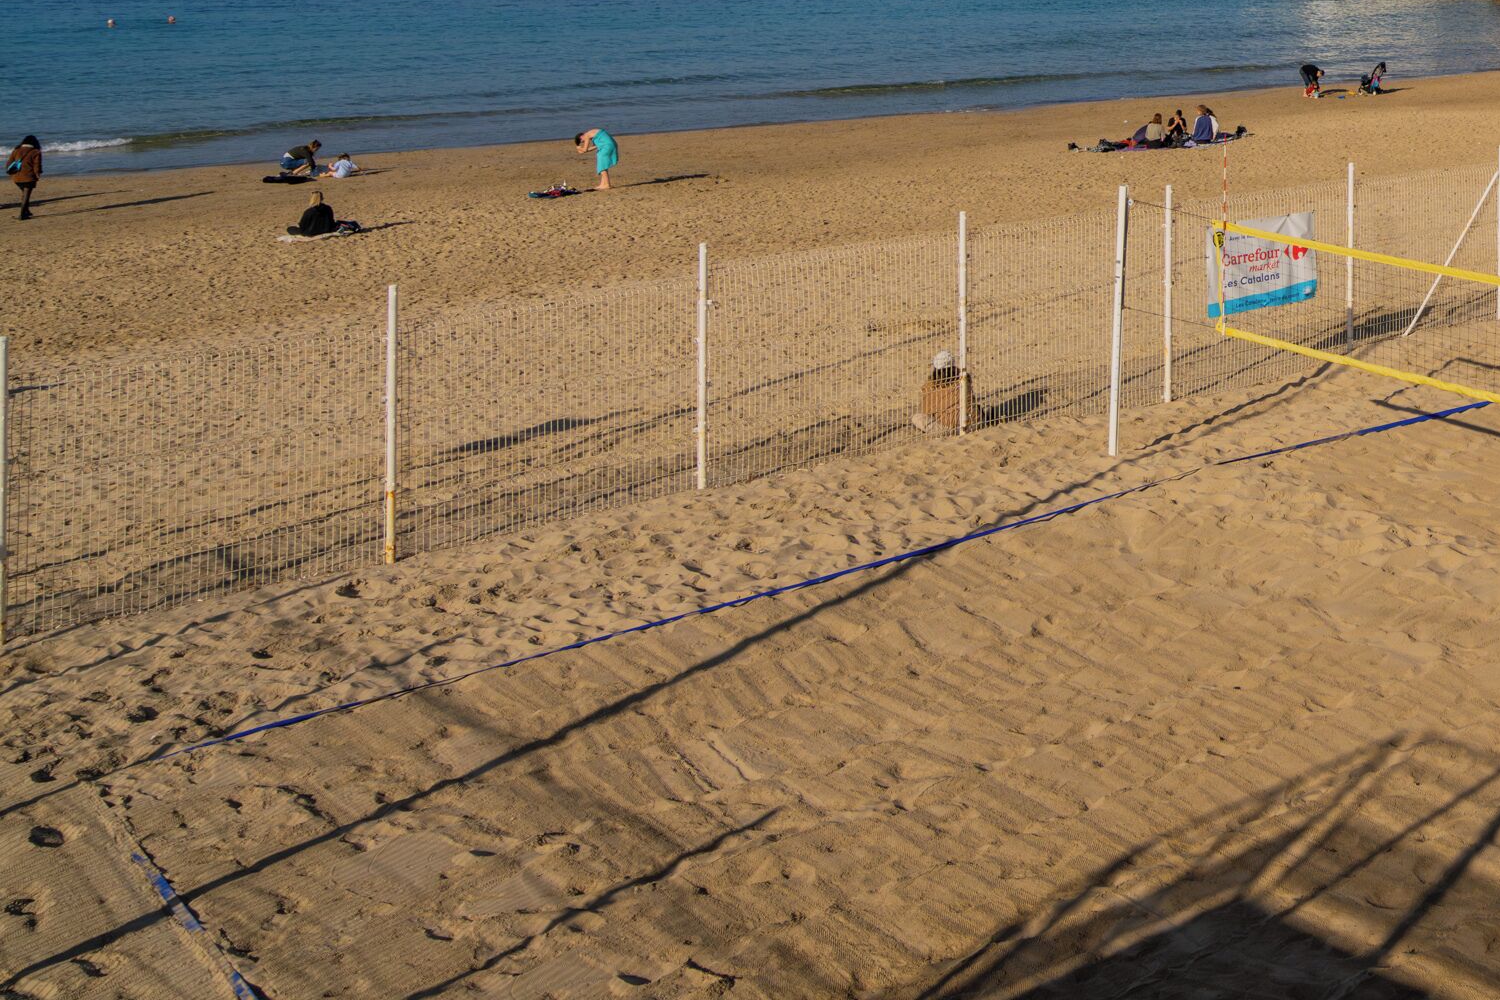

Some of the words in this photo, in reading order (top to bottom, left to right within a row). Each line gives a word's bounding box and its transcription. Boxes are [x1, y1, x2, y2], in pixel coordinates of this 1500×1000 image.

[1222, 246, 1280, 267] Carrefour
[1249, 260, 1280, 273] market
[1224, 279, 1238, 288] es
[1240, 271, 1280, 286] Catalans
